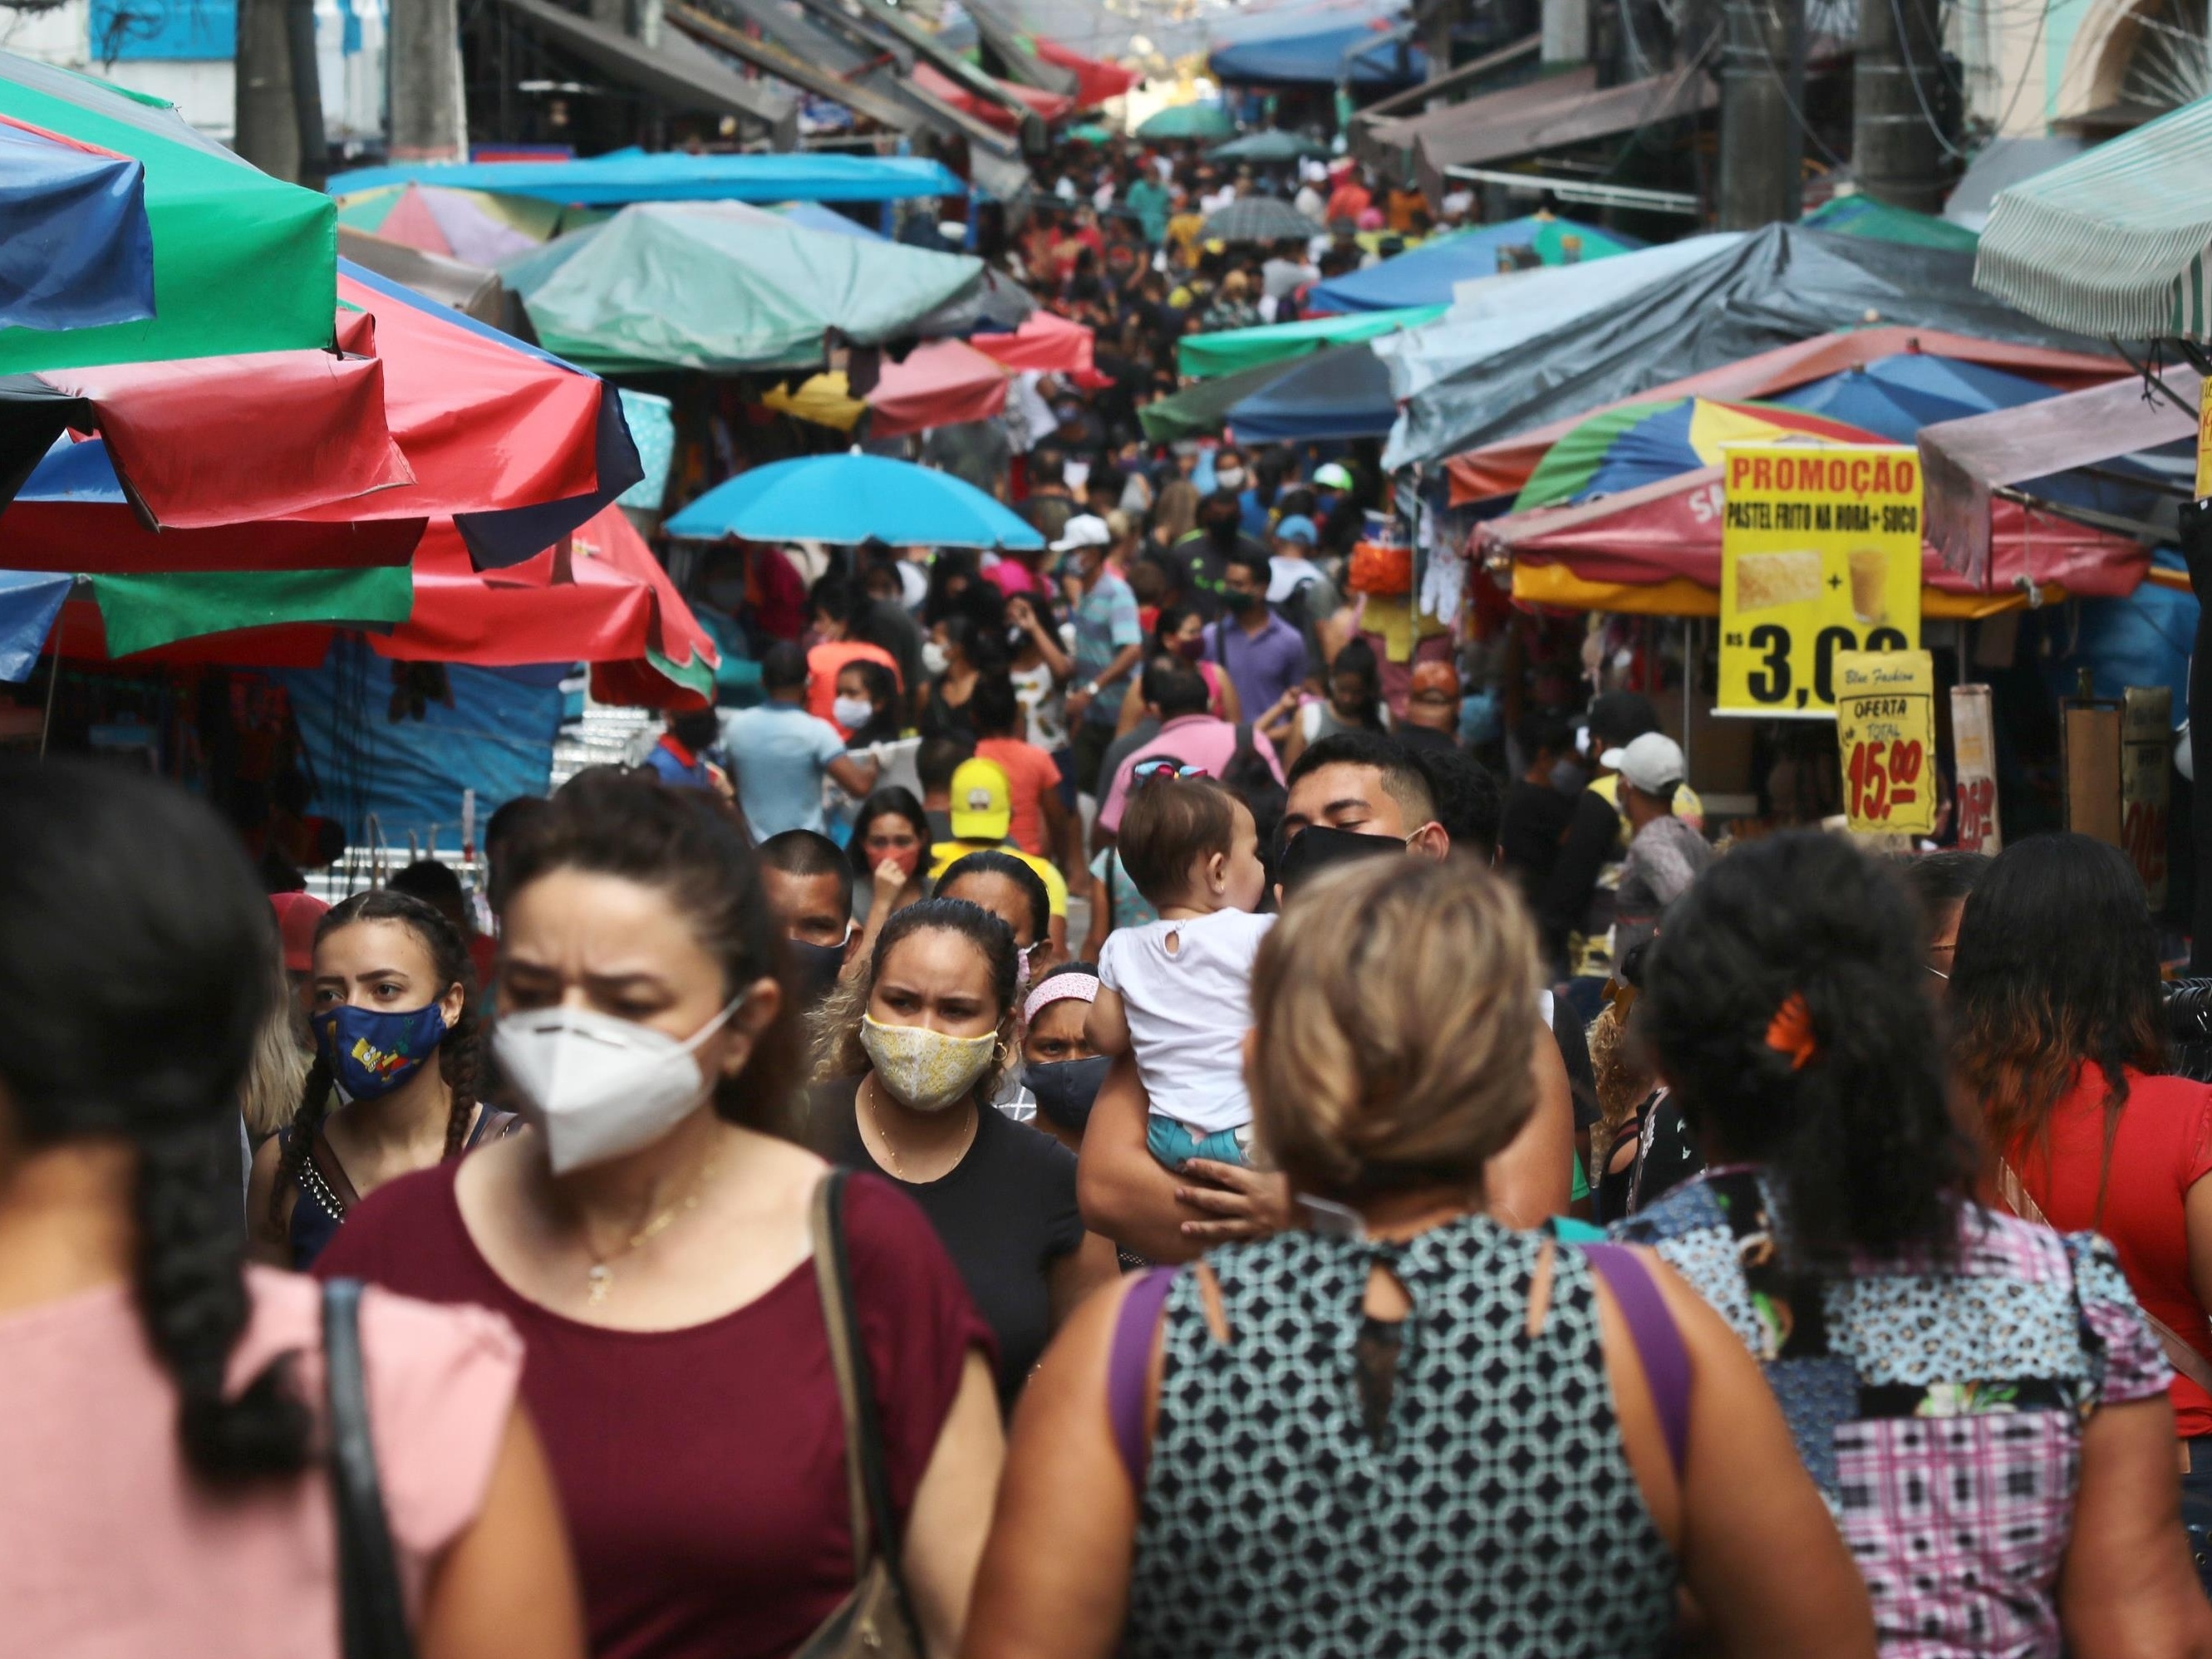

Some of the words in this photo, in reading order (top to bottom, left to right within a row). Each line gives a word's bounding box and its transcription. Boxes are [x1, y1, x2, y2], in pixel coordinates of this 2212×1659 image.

[1732, 456, 1915, 500] PROMOÇÃO
[1728, 503, 1772, 530] PASTEL
[1854, 699, 1908, 719] OFERTA
